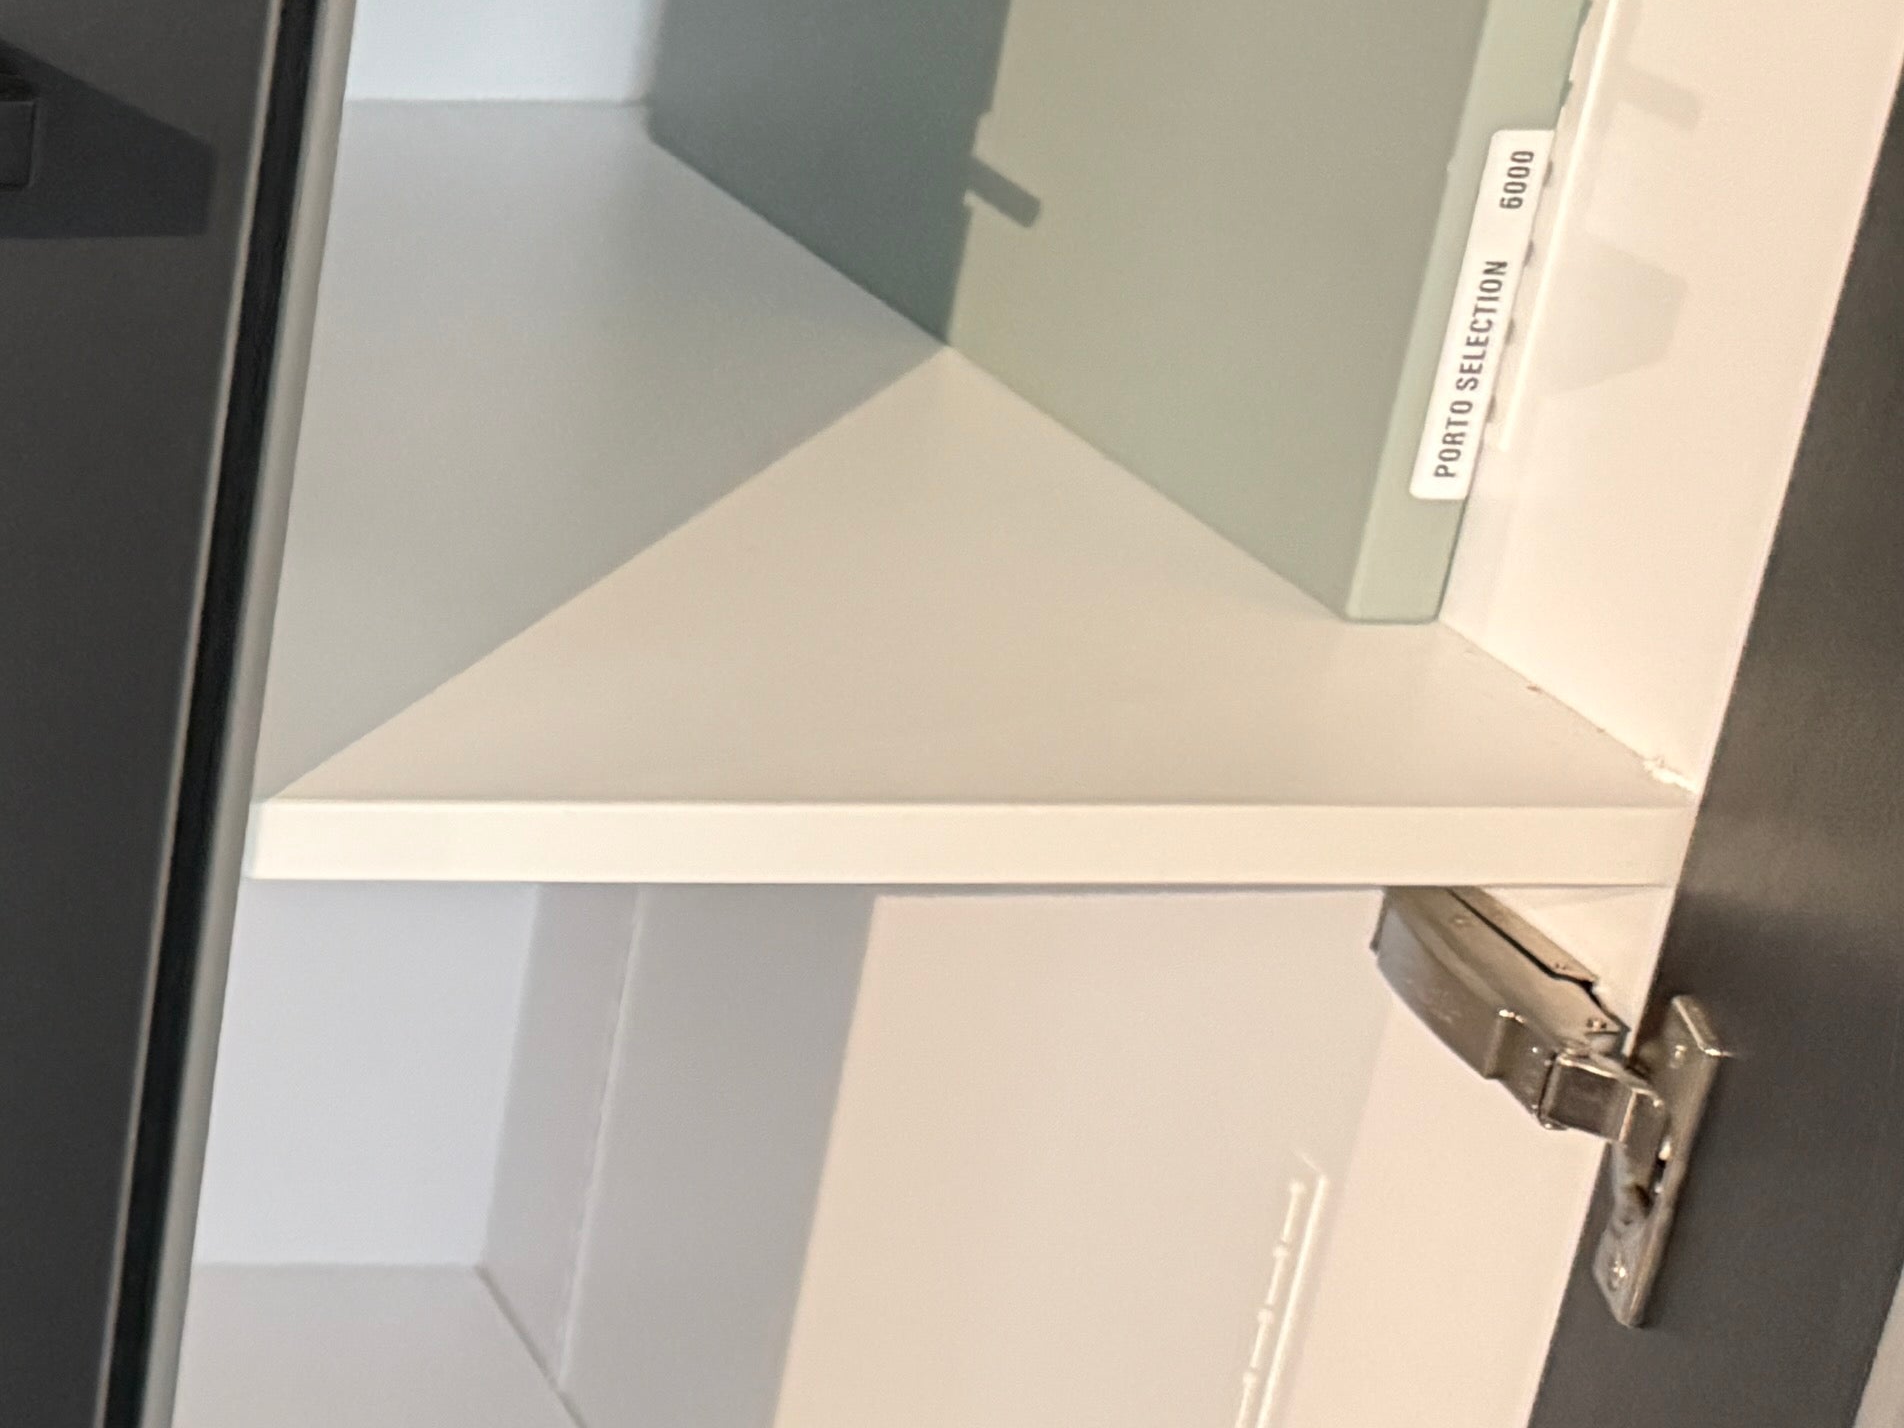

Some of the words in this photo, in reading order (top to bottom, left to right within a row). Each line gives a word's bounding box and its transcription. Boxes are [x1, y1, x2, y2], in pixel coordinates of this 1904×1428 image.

[1432, 400, 1473, 479] PORTO
[1454, 260, 1509, 392] SELECTION
[1498, 149, 1535, 211] 6000
